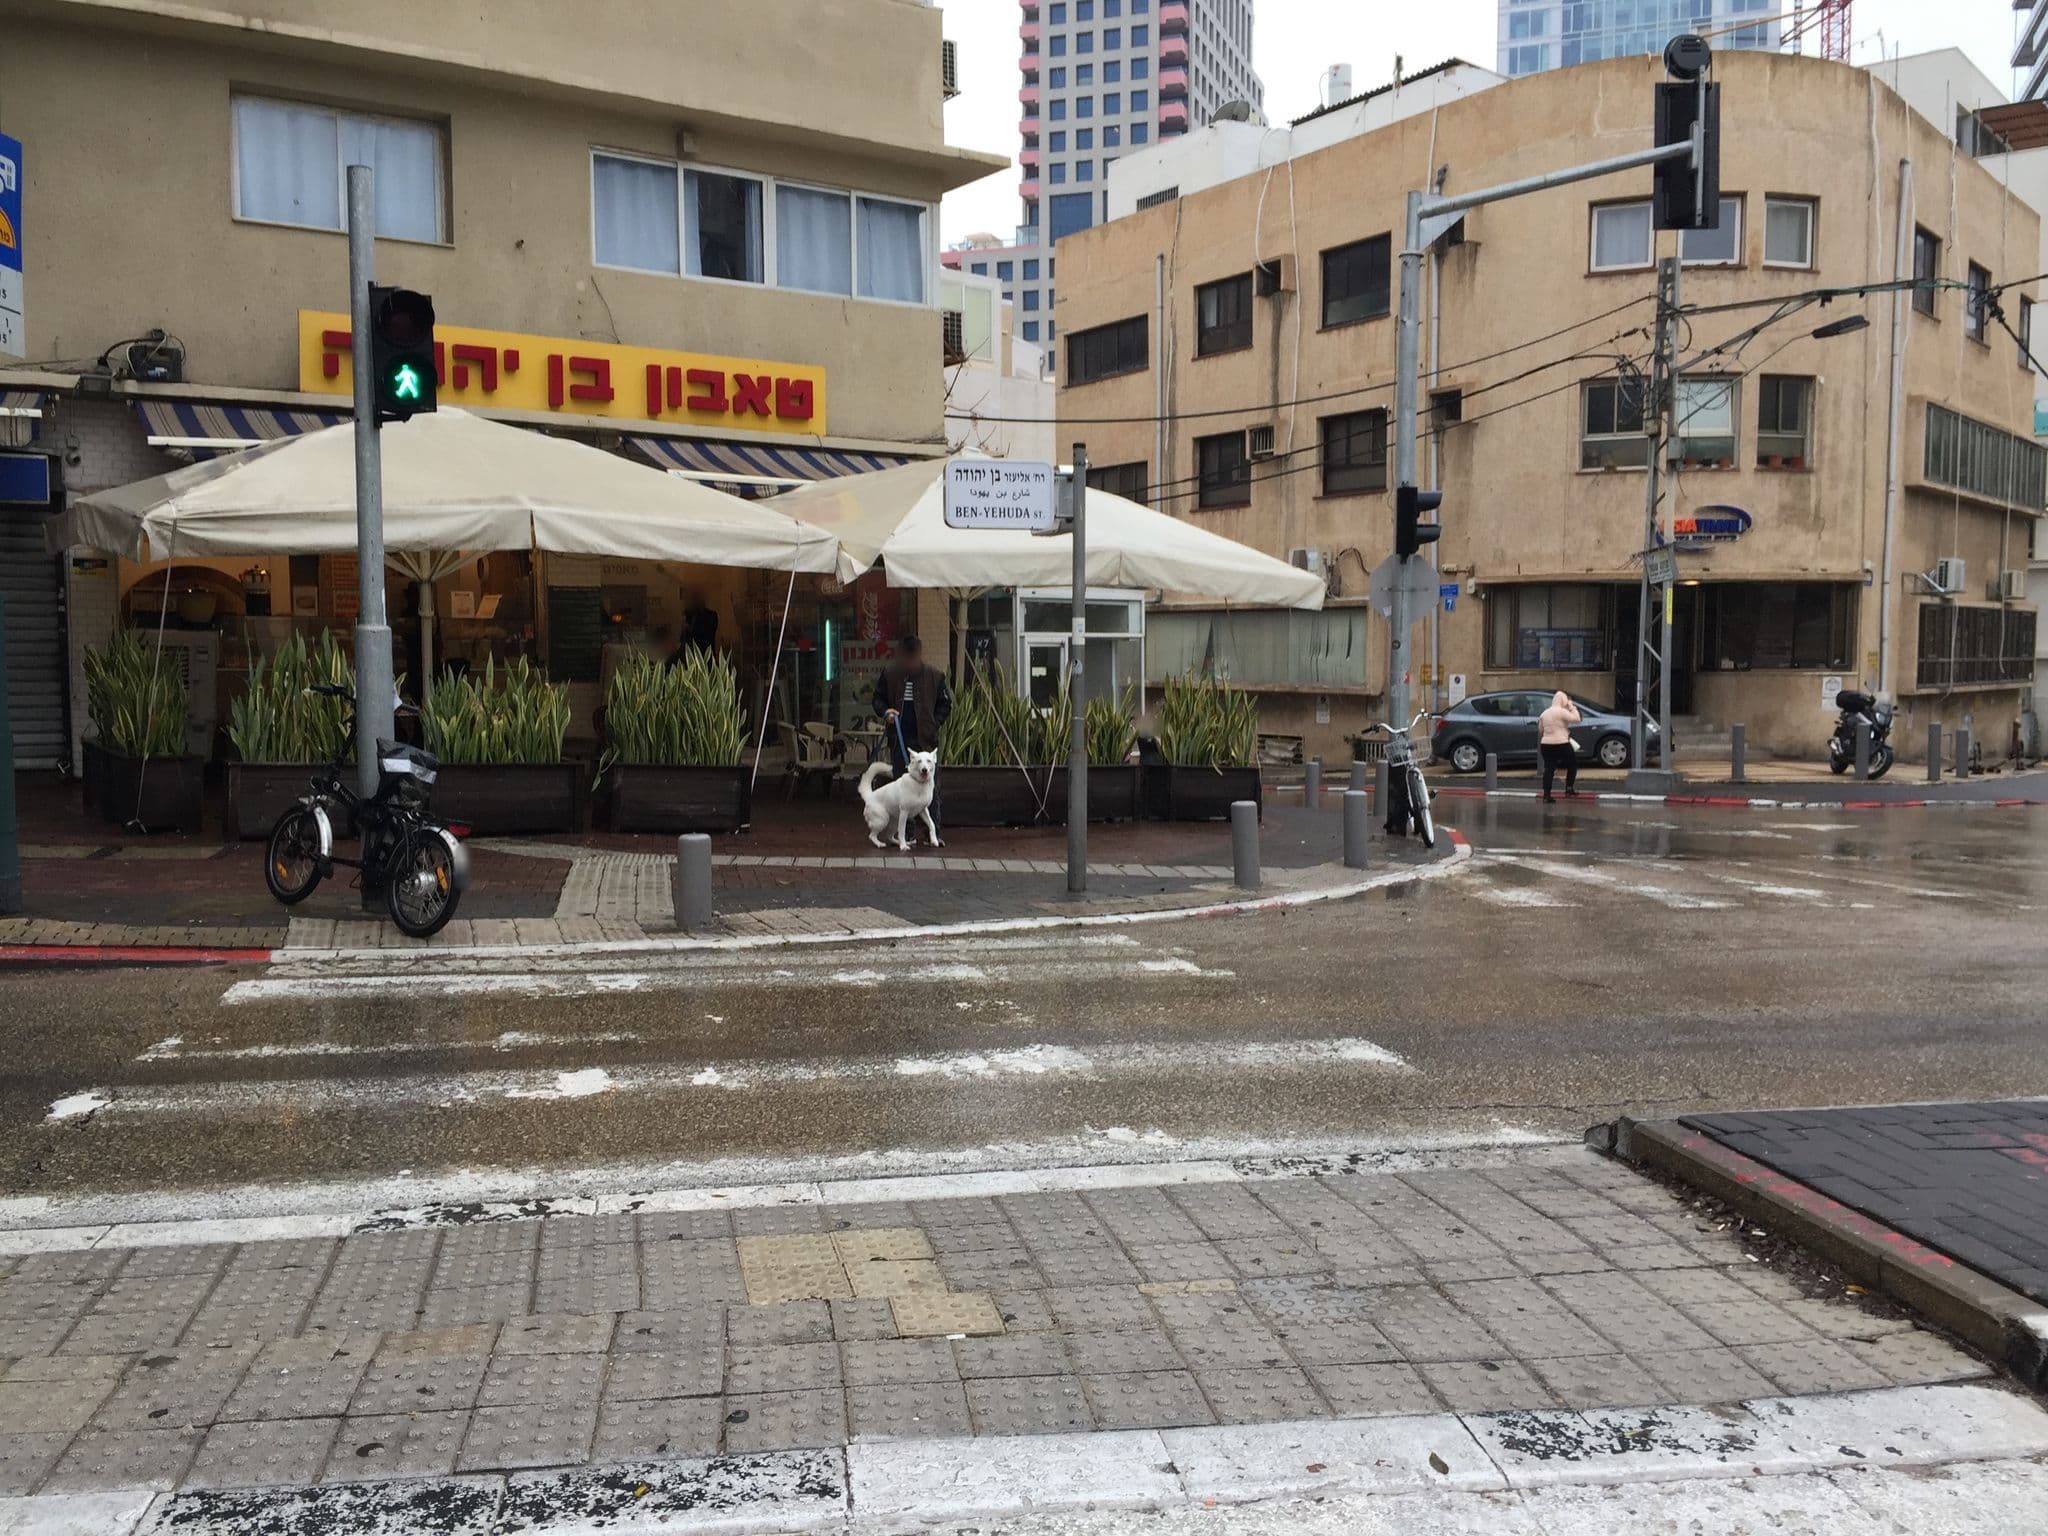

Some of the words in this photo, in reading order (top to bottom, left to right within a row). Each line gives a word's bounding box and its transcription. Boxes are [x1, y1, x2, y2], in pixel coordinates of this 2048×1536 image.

[547, 354, 615, 407] בן
[646, 363, 814, 419] טאבון
[955, 469, 986, 482] יהודה
[990, 469, 1001, 486] בן
[1004, 471, 1030, 483] אליעזר
[955, 506, 1031, 519] BEN-YEHUDA
